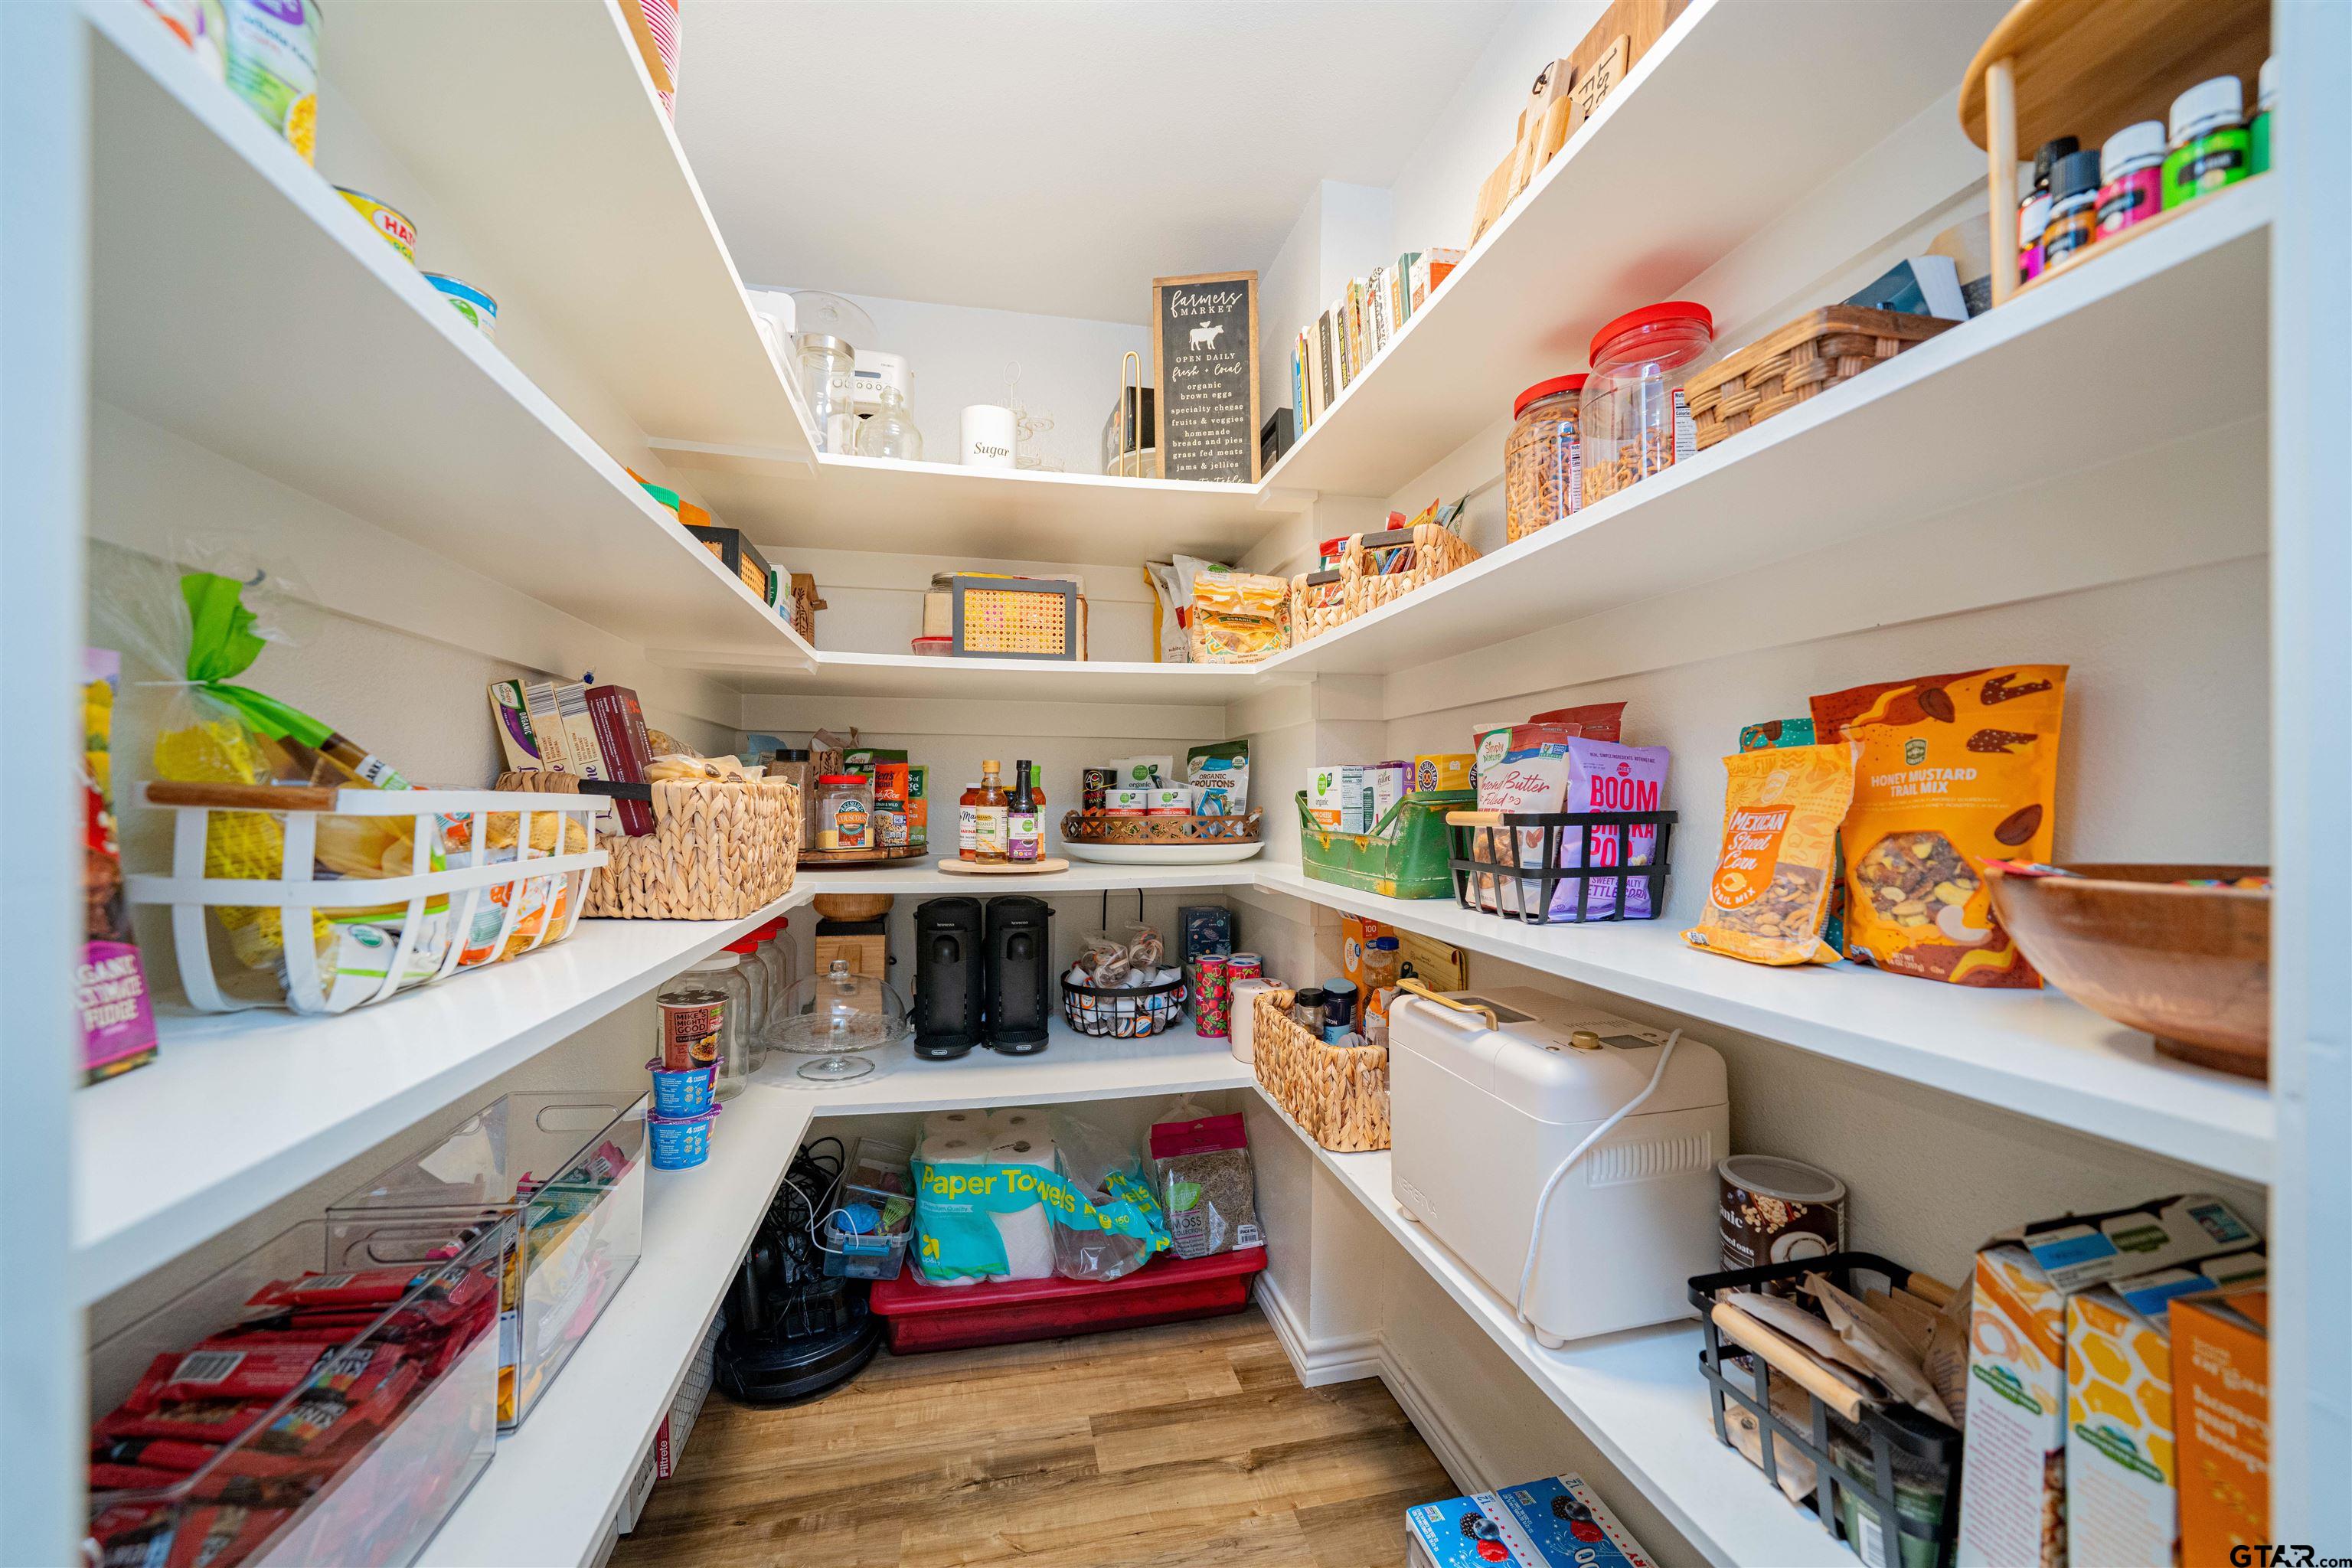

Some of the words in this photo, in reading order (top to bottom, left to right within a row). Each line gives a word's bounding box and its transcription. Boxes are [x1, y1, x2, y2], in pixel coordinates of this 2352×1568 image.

[1171, 290, 1243, 318] farmers
[1181, 305, 1233, 315] MARKET
[1172, 365, 1200, 382] fresh
[1214, 361, 1242, 375] local
[1187, 381, 1222, 390] organic
[1171, 406, 1211, 414] specialty
[1210, 416, 1243, 424] veggies
[1184, 428, 1230, 437] homemade
[973, 441, 1009, 458] Sugar
[1172, 439, 1201, 447] breads
[1210, 461, 1239, 470] jellies
[519, 711, 532, 735] ORGANIC
[1485, 741, 1504, 754] Simply
[1483, 753, 1501, 763] Nature
[1191, 779, 1235, 788] CROUTONS
[1503, 771, 1550, 793] Butter
[1871, 772, 1906, 788] HONEY
[1909, 767, 1978, 782] MUSTARD
[1589, 775, 1658, 812] BOOM
[1890, 784, 1918, 798] TRAIL
[1920, 781, 1949, 794] MIX
[1730, 812, 1787, 831] MEXICAN
[1727, 831, 1772, 851] Street
[1723, 851, 1757, 870] Corn
[1592, 877, 1614, 886] SWEET
[1627, 879, 1641, 887] ALTY
[1589, 884, 1618, 898] ETTLE
[1713, 884, 1732, 905] TRAIL
[1735, 887, 1756, 904] MIX
[677, 1009, 706, 1021] MIKE'S
[677, 1018, 706, 1027] MIGHTY
[678, 1024, 705, 1034] GOOD
[921, 1165, 998, 1200] Paper
[1001, 1169, 1076, 1213] Towels
[1114, 1215, 1130, 1225] 150
[1172, 1217, 1203, 1230] MOSS
[1736, 1243, 1754, 1256] oats
[659, 1439, 668, 1478] Filtrete
